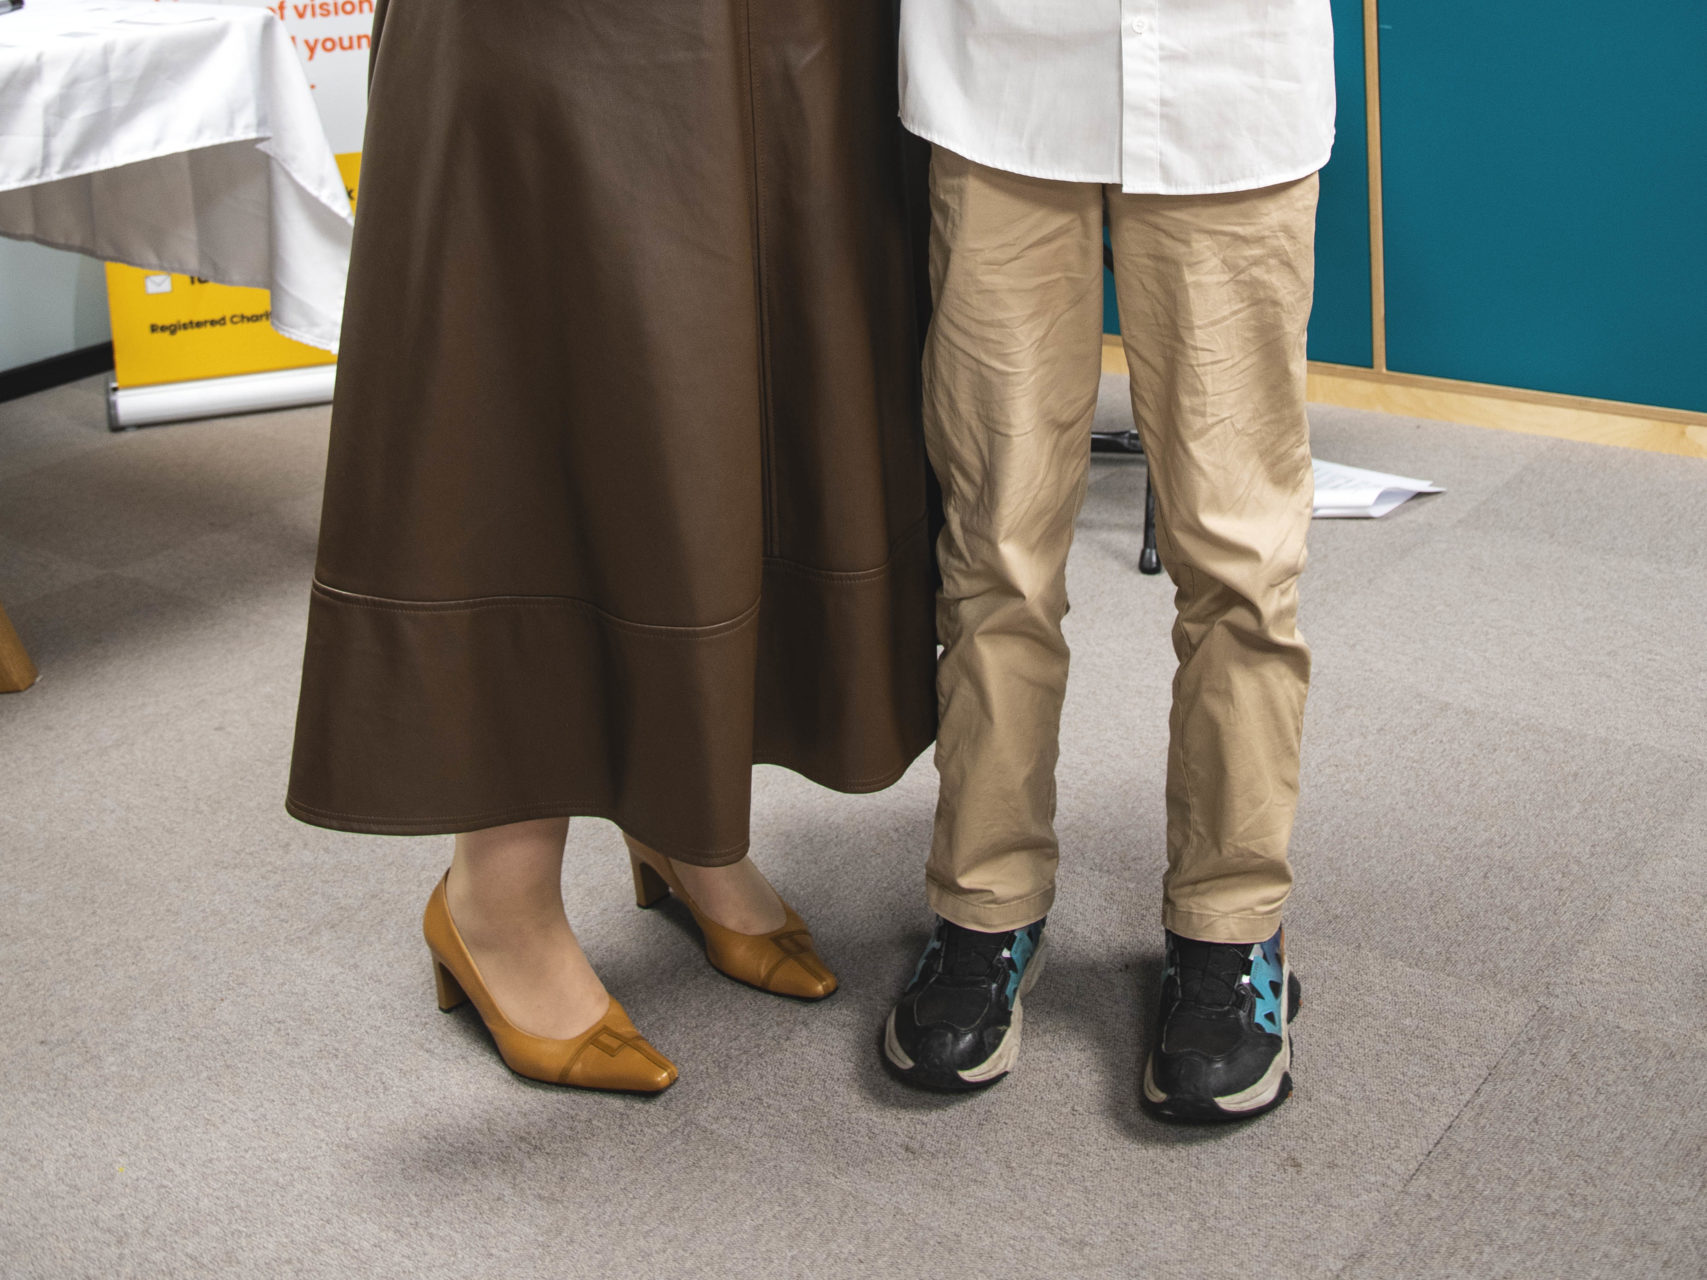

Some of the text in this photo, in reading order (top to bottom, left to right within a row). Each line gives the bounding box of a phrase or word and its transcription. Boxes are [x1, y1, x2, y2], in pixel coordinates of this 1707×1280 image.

[303, 33, 371, 62] youn
[149, 309, 272, 336] Registered Chari
